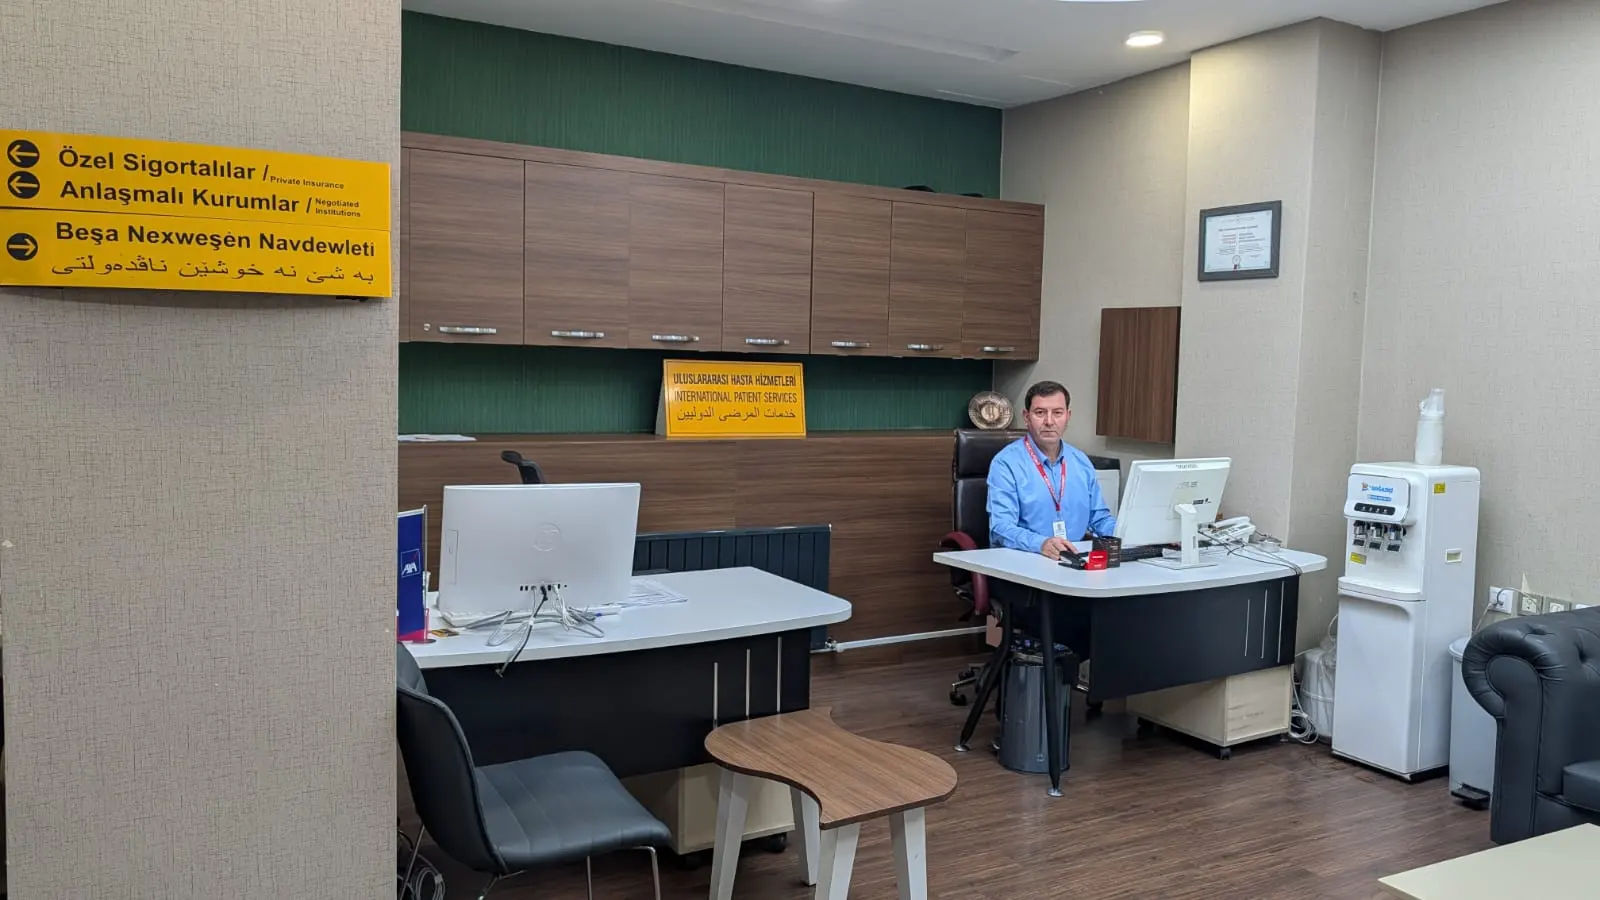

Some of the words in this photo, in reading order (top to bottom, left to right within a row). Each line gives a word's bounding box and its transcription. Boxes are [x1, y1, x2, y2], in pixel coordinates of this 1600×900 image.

[58, 145, 114, 169] Özel
[123, 153, 256, 179] Sigortalılar
[269, 175, 301, 186] Private
[302, 178, 345, 190] Insurance
[60, 180, 184, 206] Anlaşmalı
[192, 188, 300, 213] Kurumlar
[315, 198, 360, 209] Negotiated
[315, 207, 361, 218] Institutions
[56, 221, 119, 246] Beşa
[259, 232, 375, 257] Navdewleti
[673, 372, 729, 386] ULUSLARARASI
[731, 374, 753, 387] HASTA
[755, 373, 797, 387] HİZMETLERİ
[674, 390, 732, 403] INTERNATIONAL
[734, 391, 762, 404] PATIENT
[763, 391, 798, 404] SERVICES
[763, 407, 797, 419] خدمات
[401, 562, 418, 576] AXA
